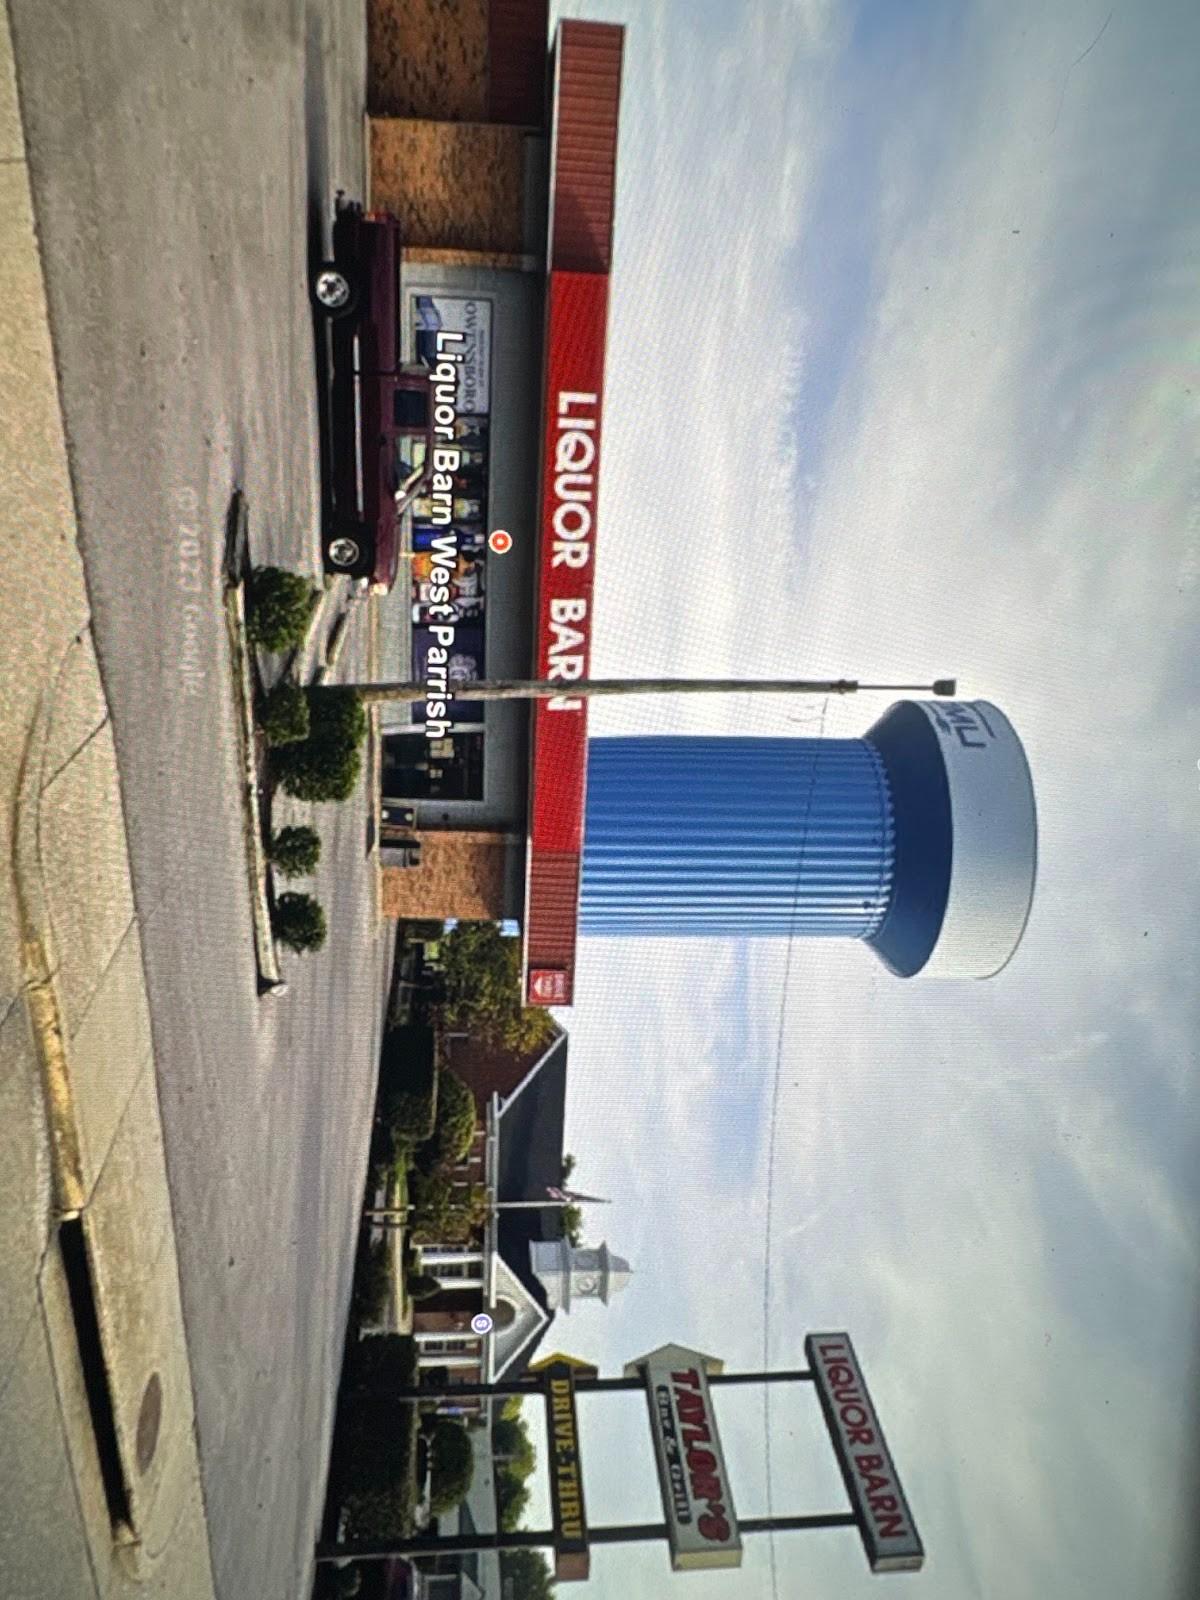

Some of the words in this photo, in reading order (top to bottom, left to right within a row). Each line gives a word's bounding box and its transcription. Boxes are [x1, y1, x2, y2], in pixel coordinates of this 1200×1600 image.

[551, 391, 597, 567] LIQUOR
[547, 598, 587, 711] BARN
[665, 1436, 677, 1455] &
[671, 1368, 731, 1541] TAYLOR'S
[819, 1343, 875, 1445] LIQUOR
[852, 1453, 908, 1538] BARN
